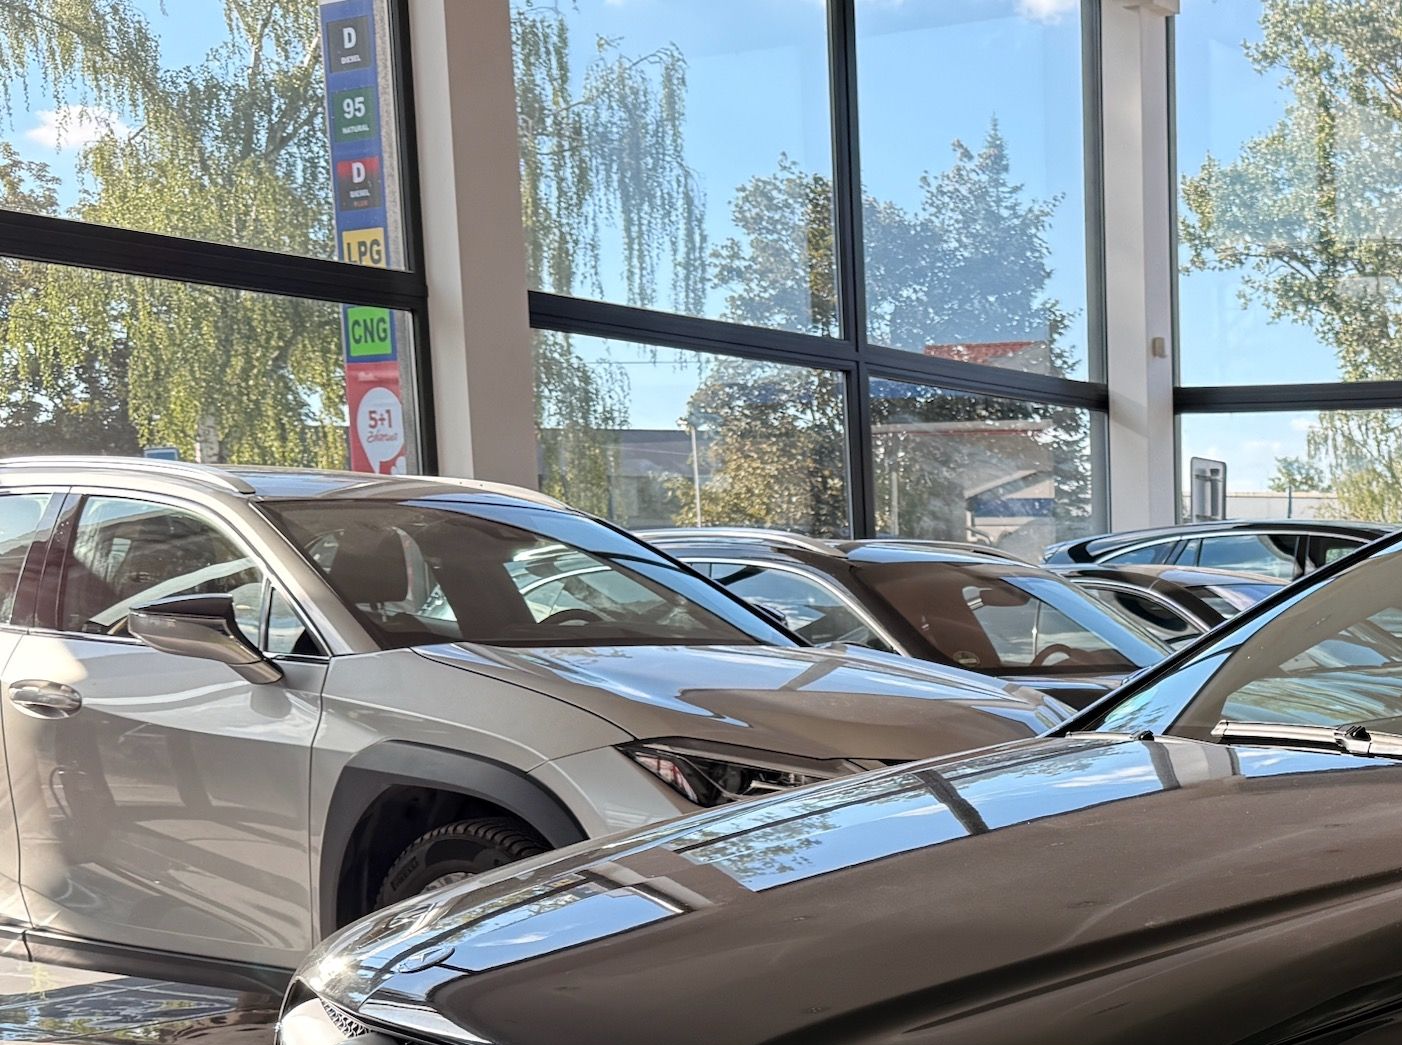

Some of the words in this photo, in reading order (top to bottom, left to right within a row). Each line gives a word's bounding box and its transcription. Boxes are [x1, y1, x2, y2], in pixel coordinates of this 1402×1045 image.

[342, 27, 357, 49] D
[340, 54, 361, 64] DIESEL
[343, 97, 366, 119] 95
[342, 124, 370, 134] NATURAL
[351, 162, 366, 183] D
[346, 238, 382, 265] LPG
[351, 316, 388, 345] CNG
[368, 409, 392, 429] 5+1
